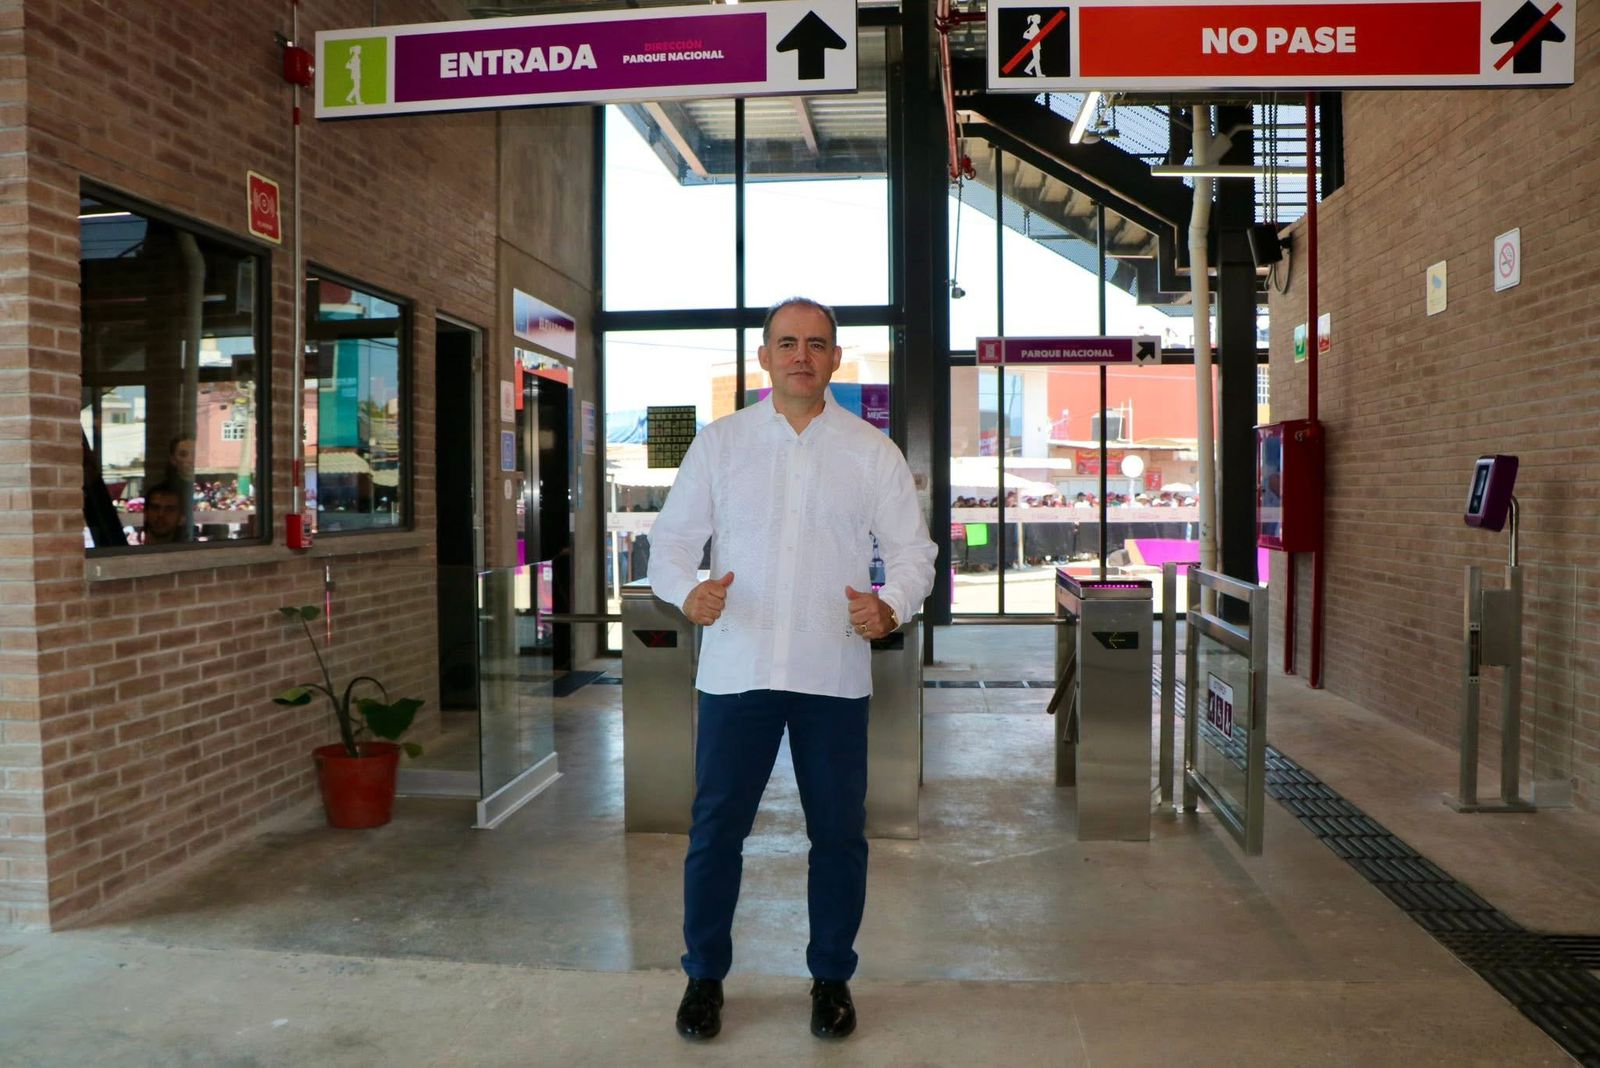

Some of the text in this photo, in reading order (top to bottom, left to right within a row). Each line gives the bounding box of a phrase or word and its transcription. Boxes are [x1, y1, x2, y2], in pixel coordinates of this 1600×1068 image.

[643, 40, 702, 51] DIRECCIÓN
[1202, 26, 1356, 54] NO PASE
[439, 44, 598, 79] ENTRADA
[622, 50, 725, 64] PARQUE NACIONAL
[1021, 349, 1114, 358] PARQUE NACIONAL
